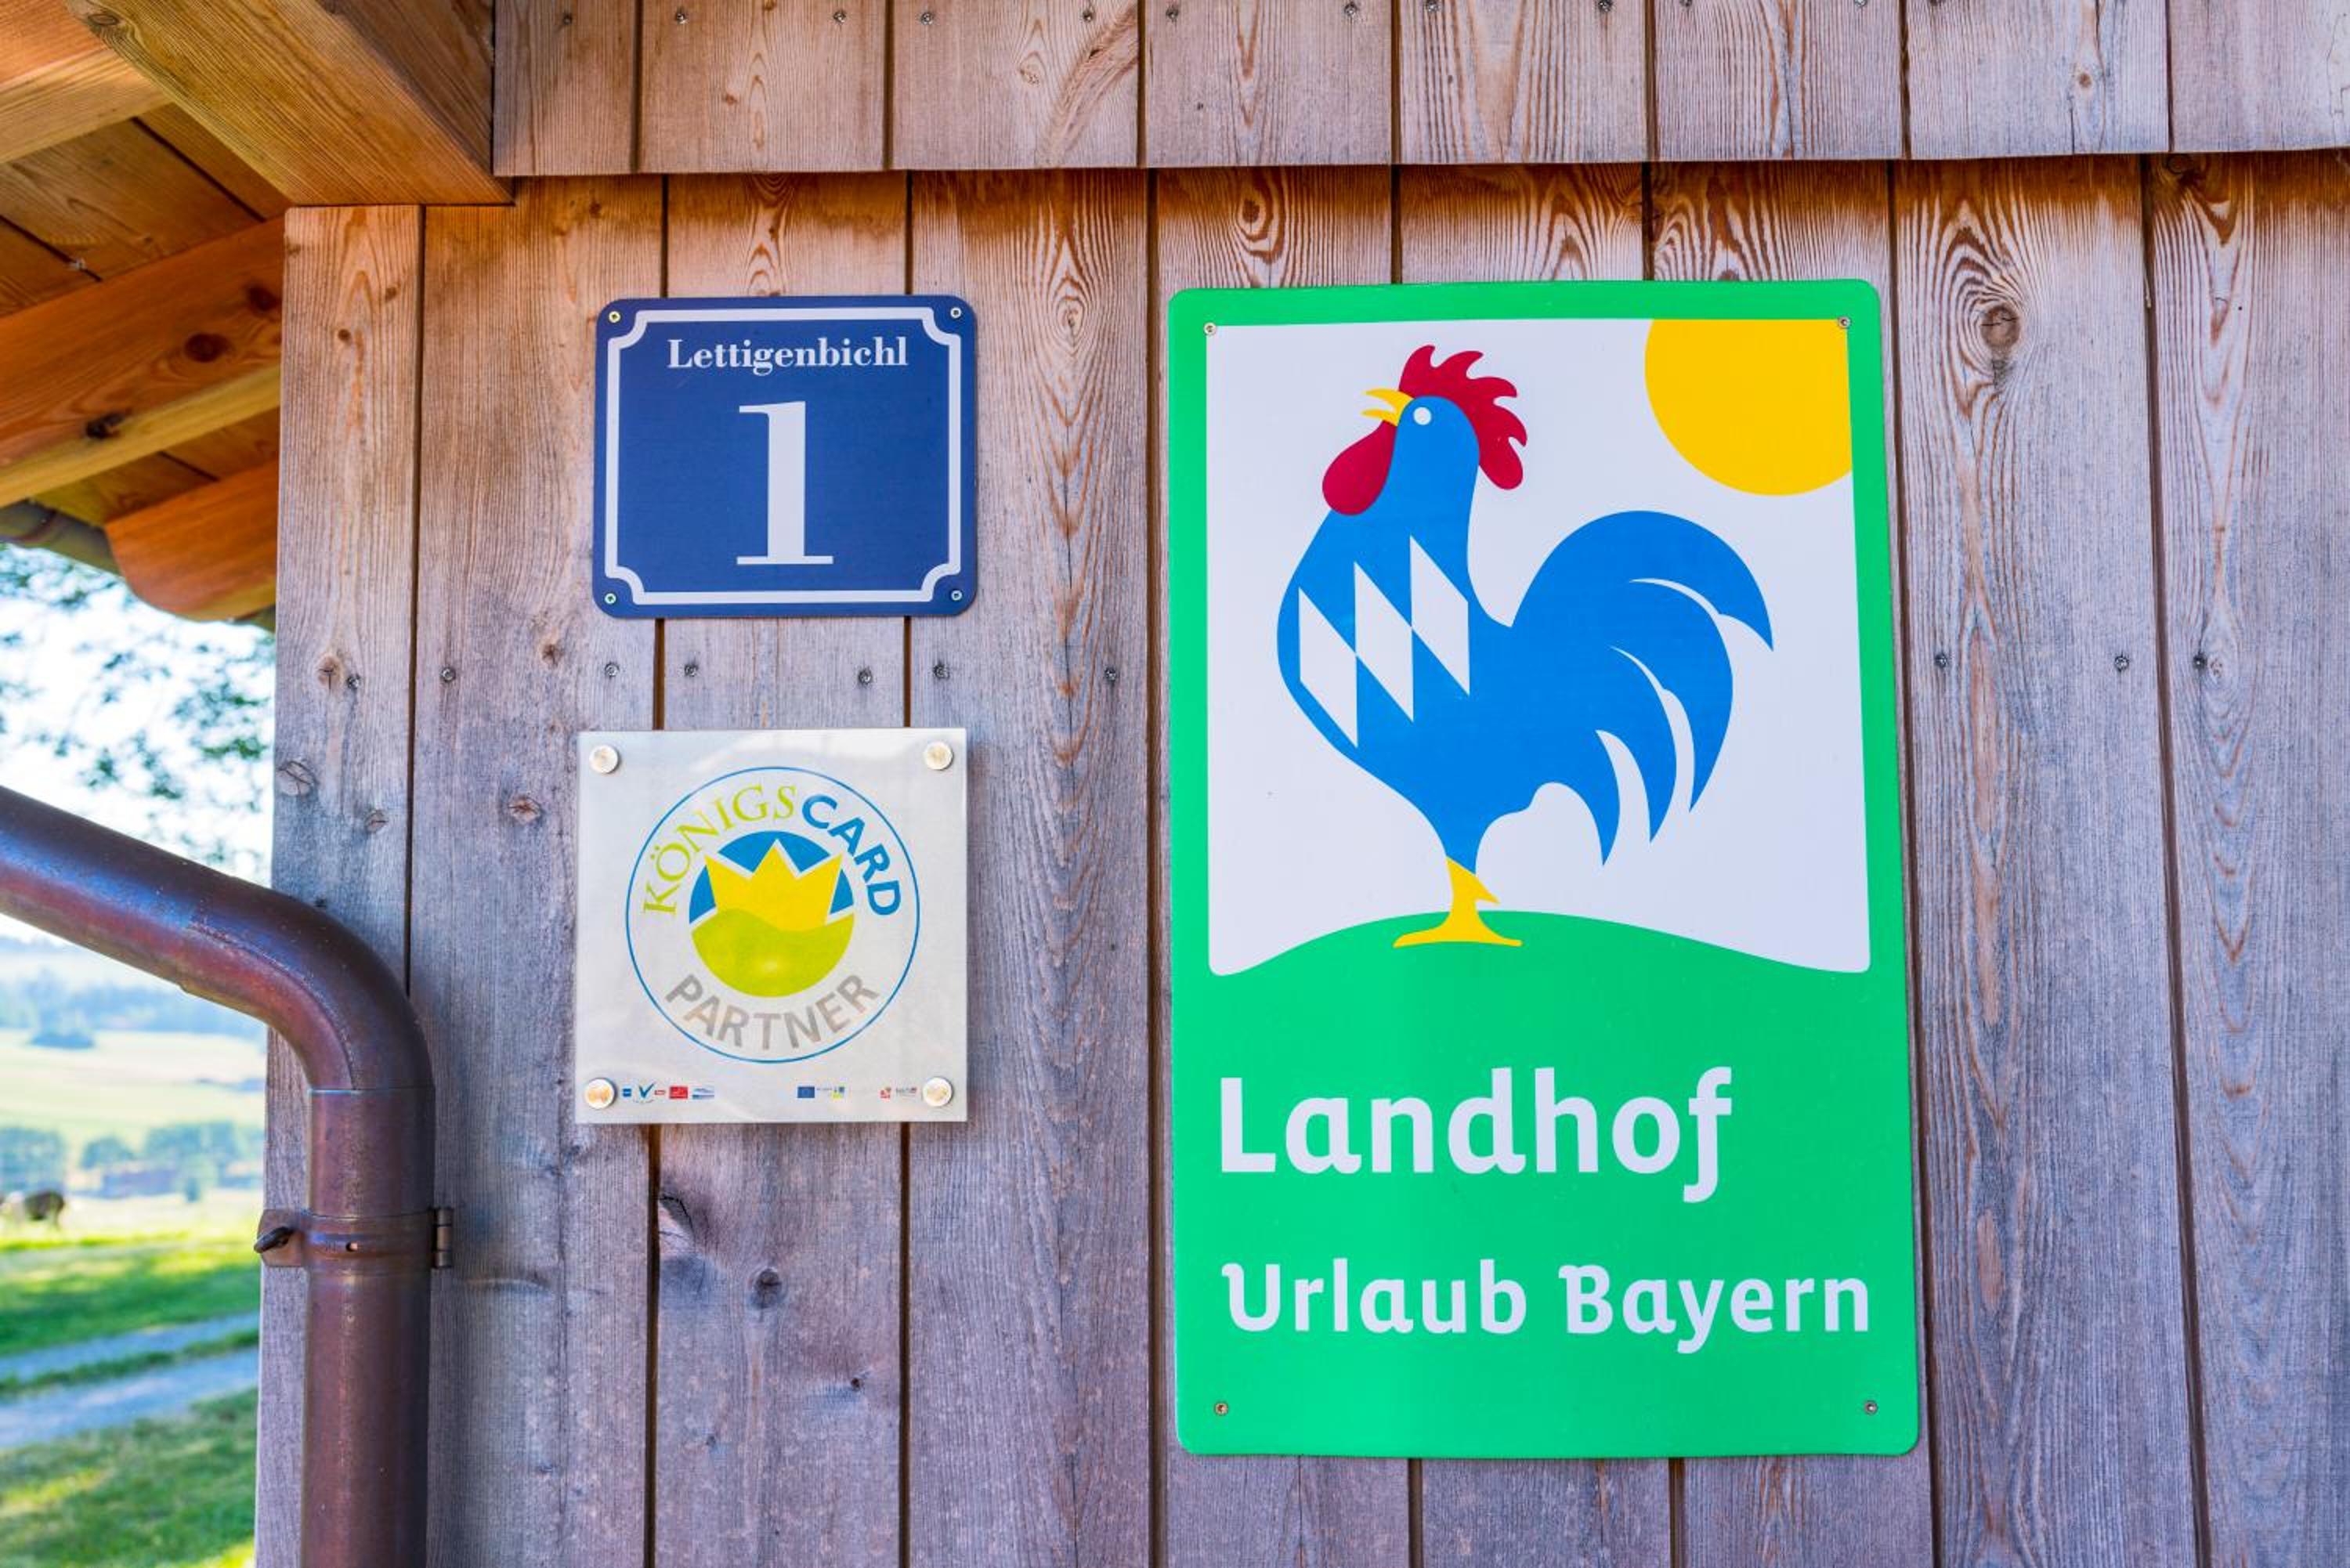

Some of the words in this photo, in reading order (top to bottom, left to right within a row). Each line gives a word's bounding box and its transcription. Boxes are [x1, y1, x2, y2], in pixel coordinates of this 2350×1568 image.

[667, 336, 909, 376] Lettigenbichl
[736, 401, 833, 565] 1
[665, 974, 880, 1050] PARTNER
[1220, 1066, 1733, 1204] Landhof
[1222, 1258, 1528, 1335] Urlaub
[1558, 1264, 1871, 1355] Bayern
